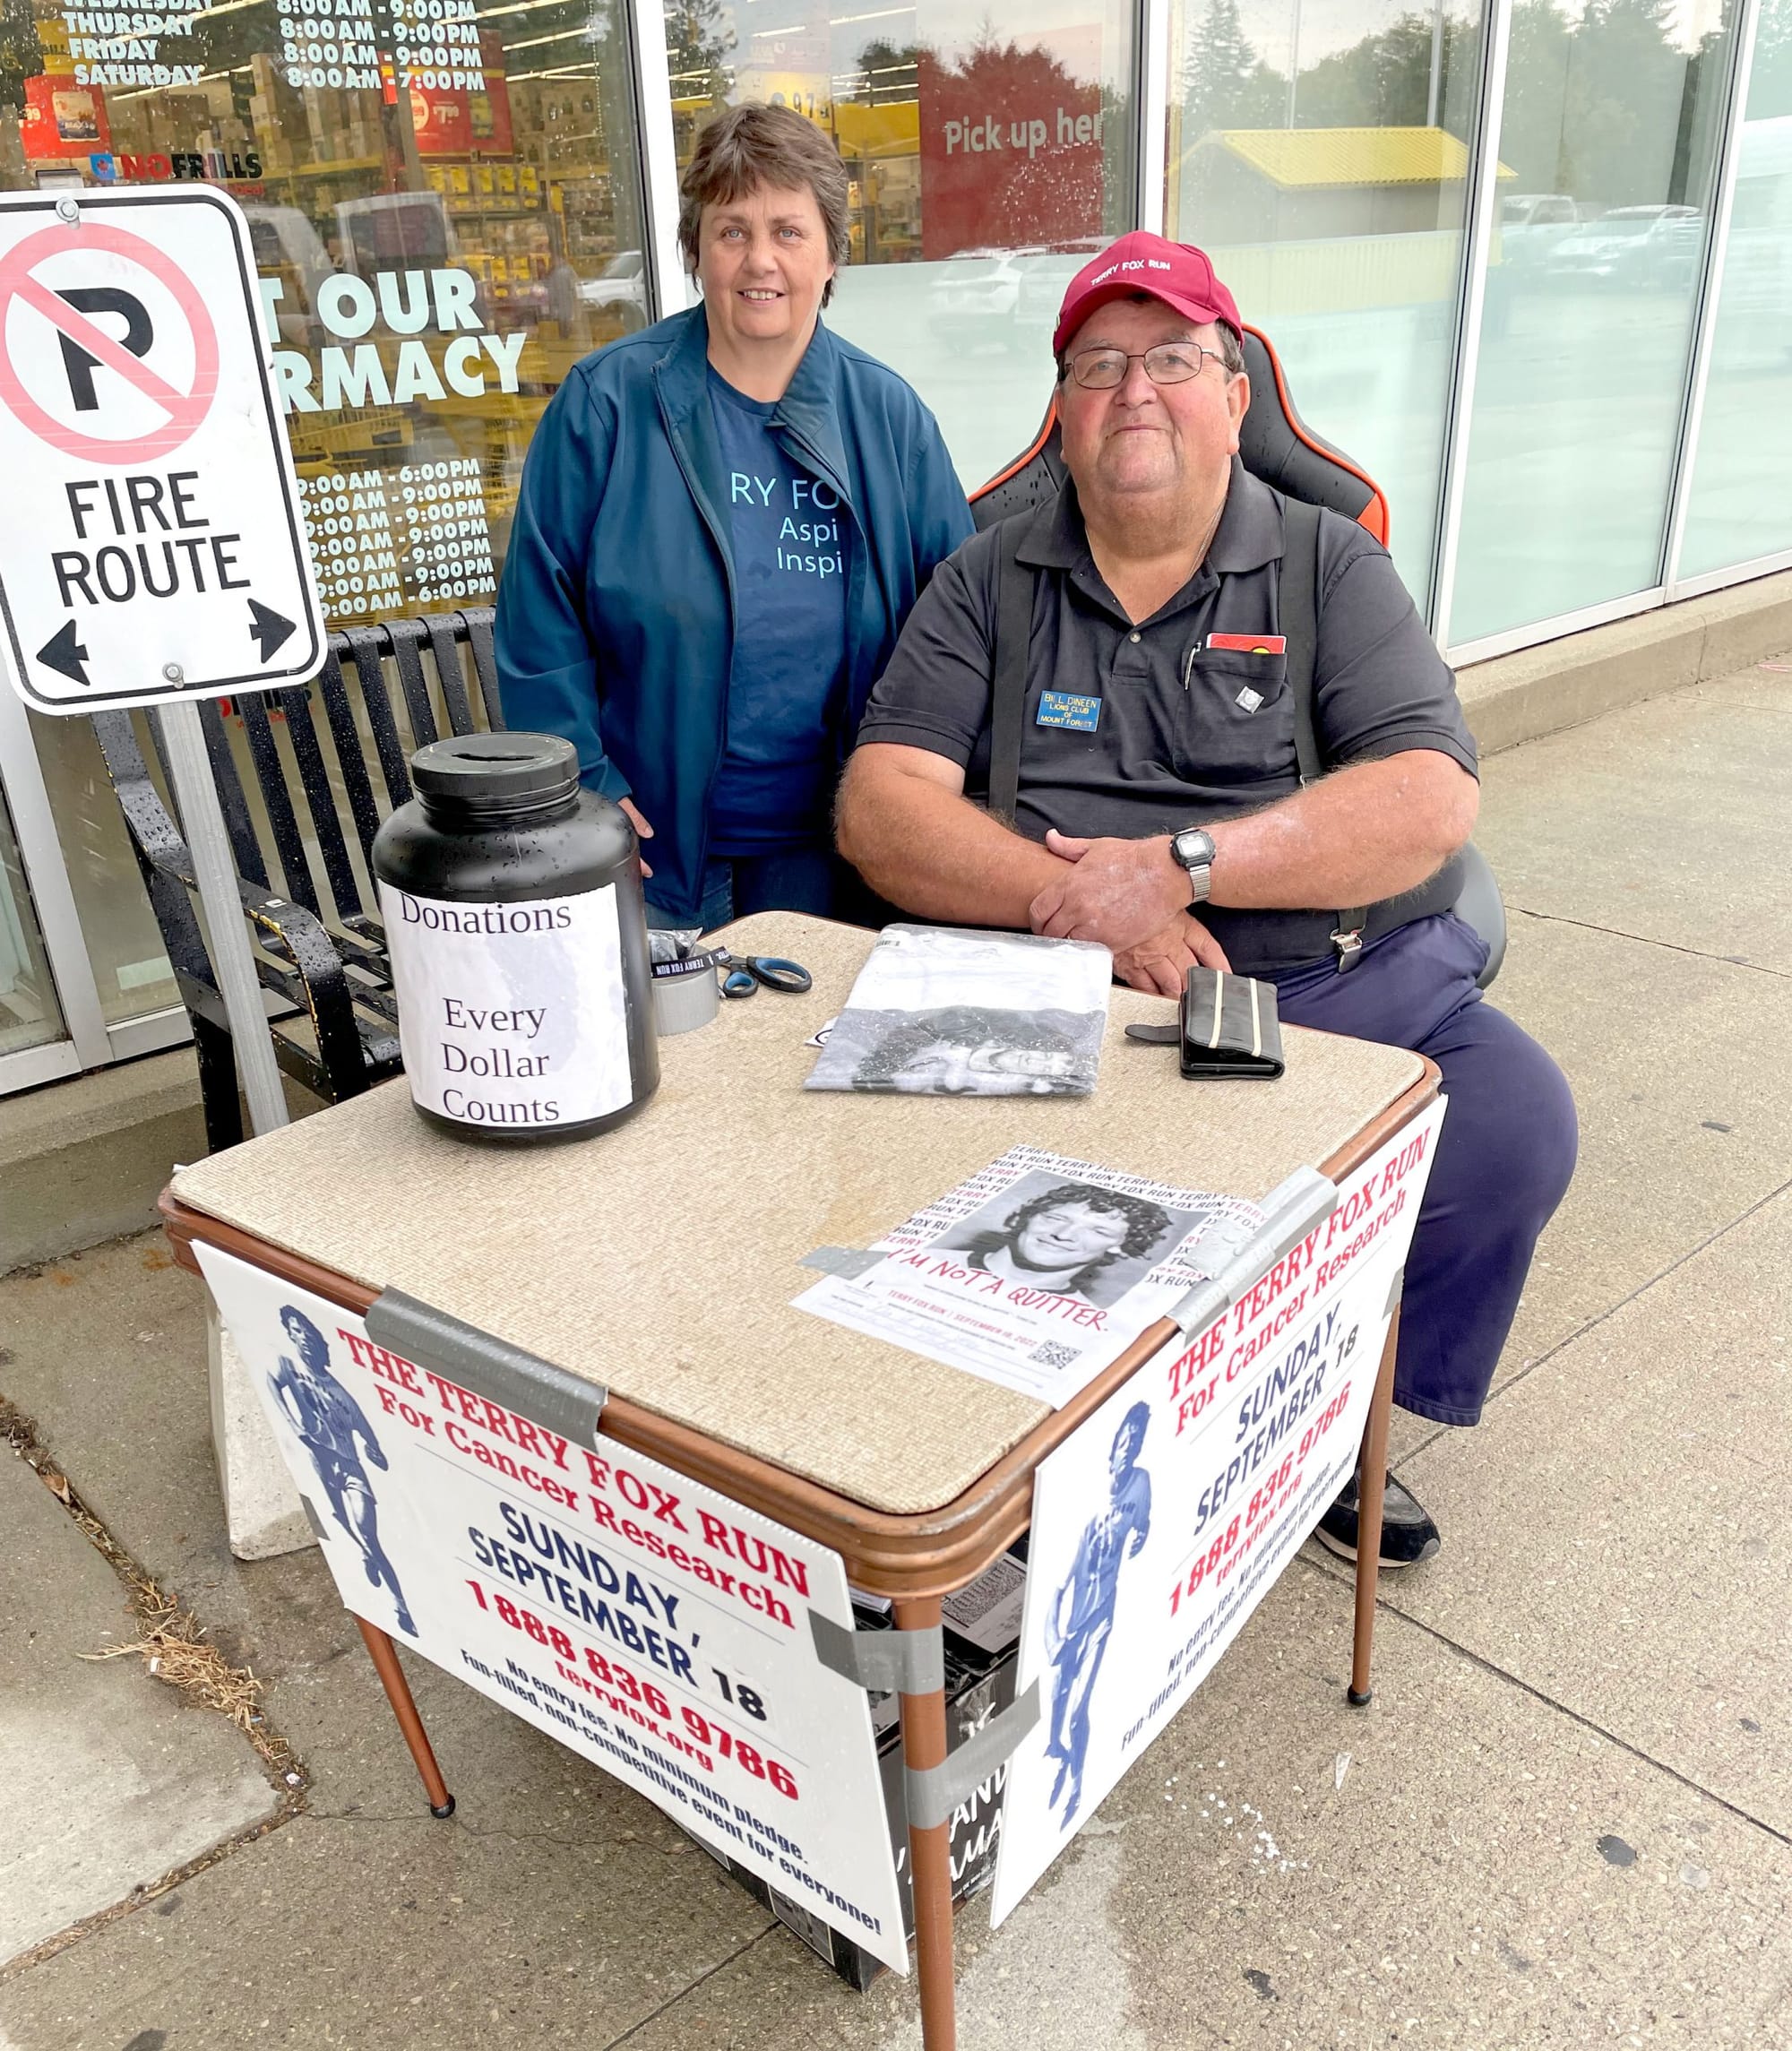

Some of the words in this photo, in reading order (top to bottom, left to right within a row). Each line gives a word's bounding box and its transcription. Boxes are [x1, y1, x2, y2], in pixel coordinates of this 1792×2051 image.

[61, 12, 195, 36] THURSDAY
[69, 38, 158, 60] FRIDAY
[74, 64, 202, 86] SATURDAY
[945, 115, 1003, 155] Pick
[1011, 118, 1047, 159] up
[1090, 263, 1119, 286] TERRY
[1122, 259, 1145, 271] FOX
[1148, 259, 1171, 271] RUN
[317, 268, 485, 339] OUR
[65, 470, 211, 539] FIRE
[780, 516, 839, 548] Aspi
[51, 533, 252, 608] ROUTE
[777, 547, 843, 579] Inspi
[1040, 715, 1064, 724] MOUNT
[1070, 706, 1090, 714] CLUB
[399, 890, 572, 934] Donations
[656, 965, 671, 975] RUN
[670, 962, 684, 973] FOX
[443, 997, 547, 1038] Every
[440, 1042, 550, 1078] Dollar
[443, 1089, 560, 1123] Counts
[981, 1167, 1022, 1177] TERRY
[991, 1159, 1019, 1168] RUN
[1060, 1168, 1084, 1177] FOX
[1087, 1172, 1115, 1181] RUN
[1116, 1176, 1156, 1187] TERRY
[1027, 1155, 1055, 1164] RUN
[1056, 1159, 1095, 1170] TERRY
[959, 1182, 988, 1190] RUN
[970, 1175, 994, 1183] FOX
[1120, 1185, 1144, 1195] FOX
[1146, 1188, 1175, 1199] RUN
[1178, 1192, 1219, 1202] TERRY
[926, 1204, 956, 1213] RUN
[938, 1196, 963, 1205] FOX
[950, 1189, 992, 1200] TERRY
[904, 1218, 931, 1228] FOX
[1227, 1201, 1269, 1222] TERRY
[1234, 1214, 1260, 1231] FOX
[883, 1235, 926, 1246] TERRY
[892, 1226, 922, 1236] RUN
[887, 1248, 930, 1269] I'M
[928, 1260, 992, 1286] NOT
[979, 1279, 1004, 1295] A
[1167, 1314, 1228, 1402] THE
[1234, 1225, 1322, 1337] TERRY
[1324, 1173, 1378, 1249] FOX
[1379, 1125, 1431, 1200] RUN
[1175, 1375, 1219, 1437] For
[1226, 1285, 1309, 1383] Cancer
[1313, 1187, 1407, 1298] Research
[1193, 1359, 1327, 1537] SEPTEMBER
[1335, 1323, 1360, 1369] 18
[336, 1326, 426, 1398] THE
[424, 1371, 571, 1471] TERRY
[582, 1450, 691, 1535] FOX
[696, 1507, 810, 1599] RUN
[374, 1383, 436, 1437] For
[444, 1420, 580, 1512] Cancer
[588, 1494, 797, 1630] Research
[1168, 1579, 1183, 1618] 1
[1187, 1513, 1241, 1597] 888
[1245, 1451, 1294, 1529] 836
[1297, 1380, 1352, 1465] 9786
[468, 1526, 699, 1688] SEPTEMBER
[711, 1667, 768, 1722] 18
[465, 1579, 489, 1612] 1
[493, 1593, 577, 1662] 888
[583, 1647, 672, 1720] 836
[680, 1706, 799, 1801] 9786
[555, 1659, 715, 1773] terryfox.org
[505, 1658, 530, 1683] No
[531, 1676, 577, 1713] entry
[578, 1702, 614, 1735] fee.
[615, 1724, 639, 1751] No
[642, 1744, 731, 1814] minimum
[733, 1805, 809, 1865] pledge.
[461, 1648, 543, 1712] Fun-filled,
[544, 1702, 688, 1805] non-competitive
[691, 1797, 745, 1844] event
[746, 1832, 774, 1863] for
[779, 1857, 883, 1936] everyone!
